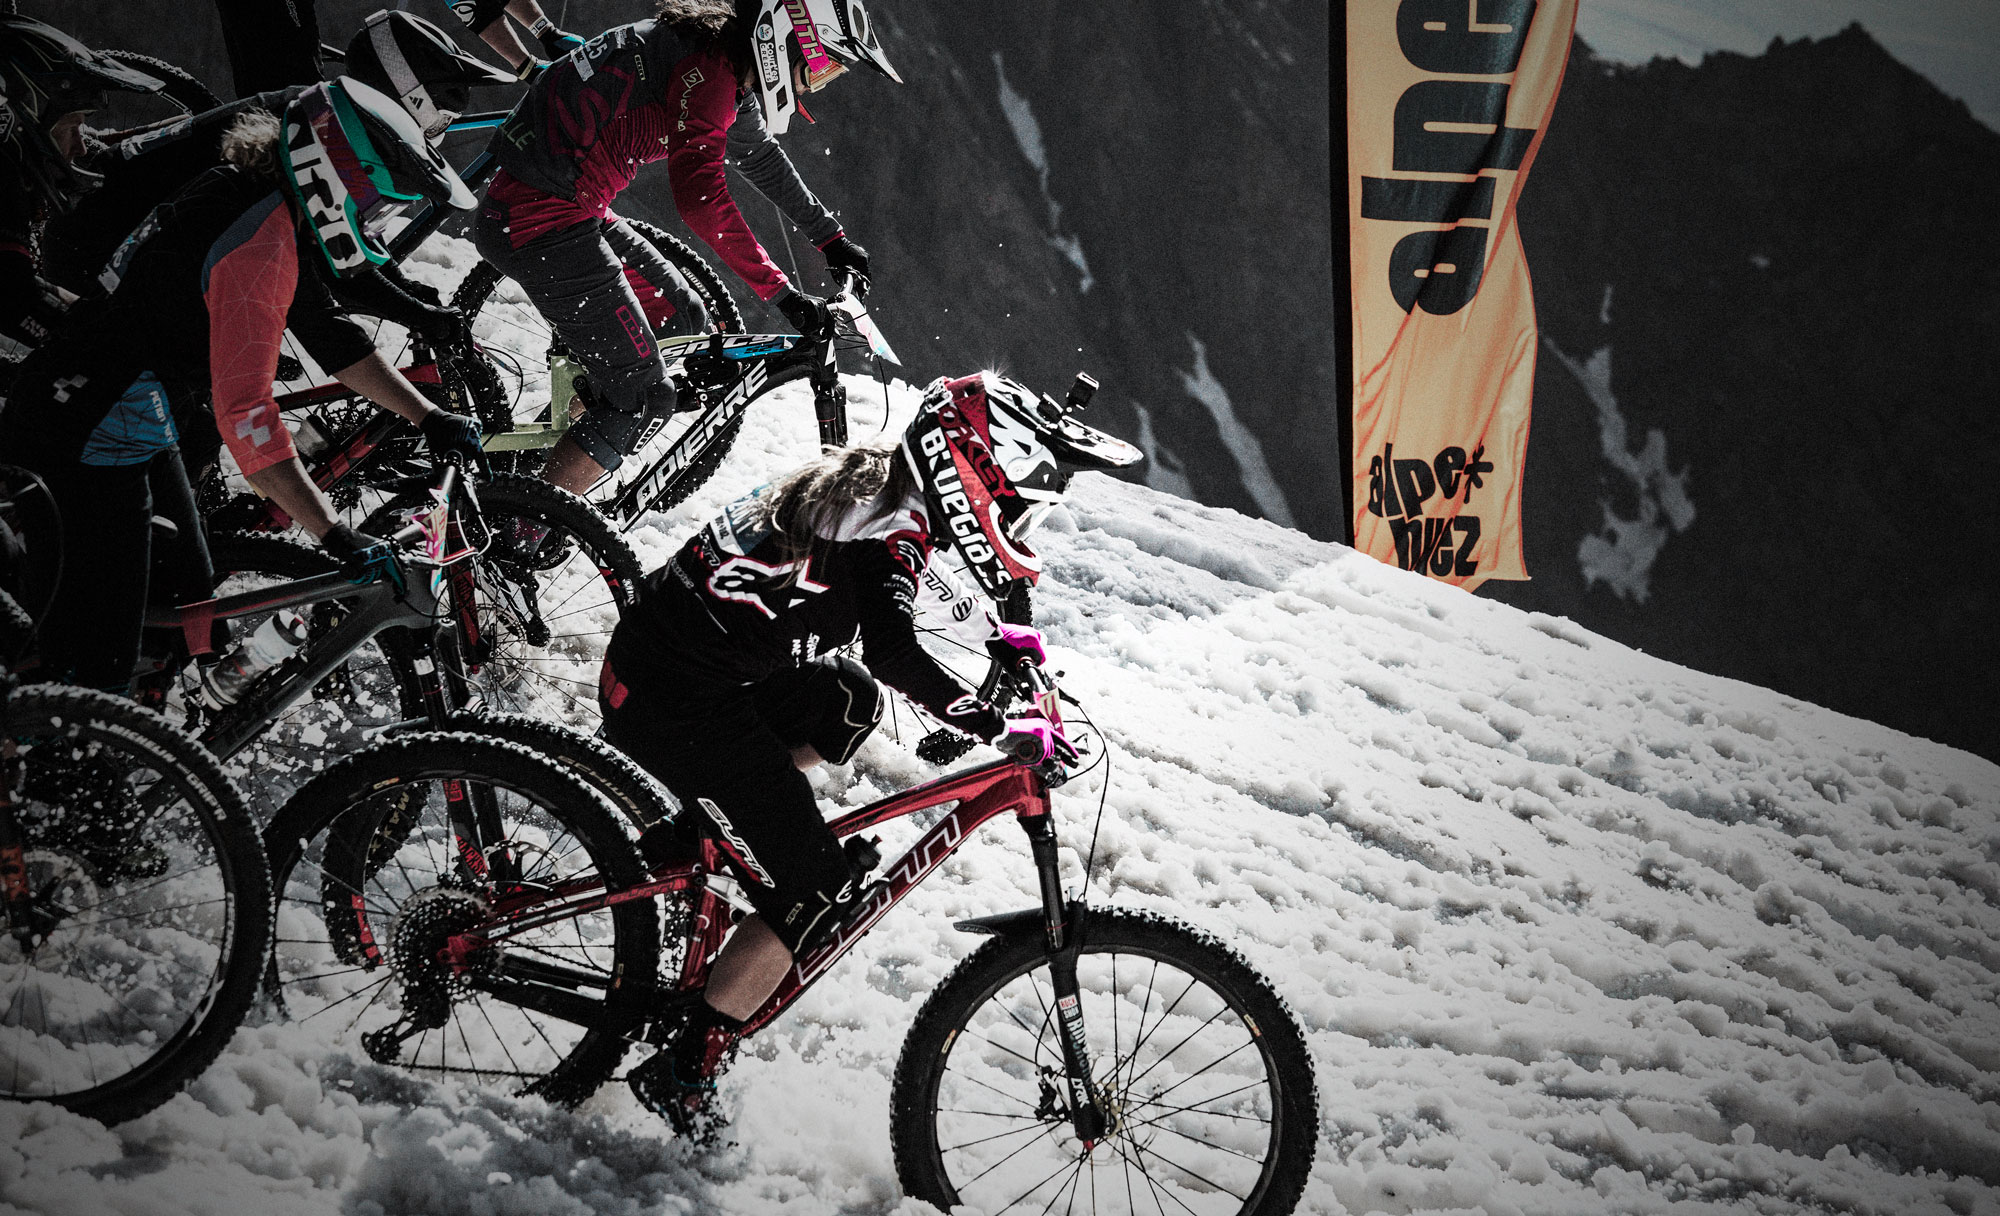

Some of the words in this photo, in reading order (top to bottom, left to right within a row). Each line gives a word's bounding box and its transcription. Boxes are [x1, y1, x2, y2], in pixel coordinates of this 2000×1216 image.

[660, 335, 779, 358] SPCY
[614, 358, 768, 534] LAPIERRE
[938, 405, 1016, 498] OAKLEY
